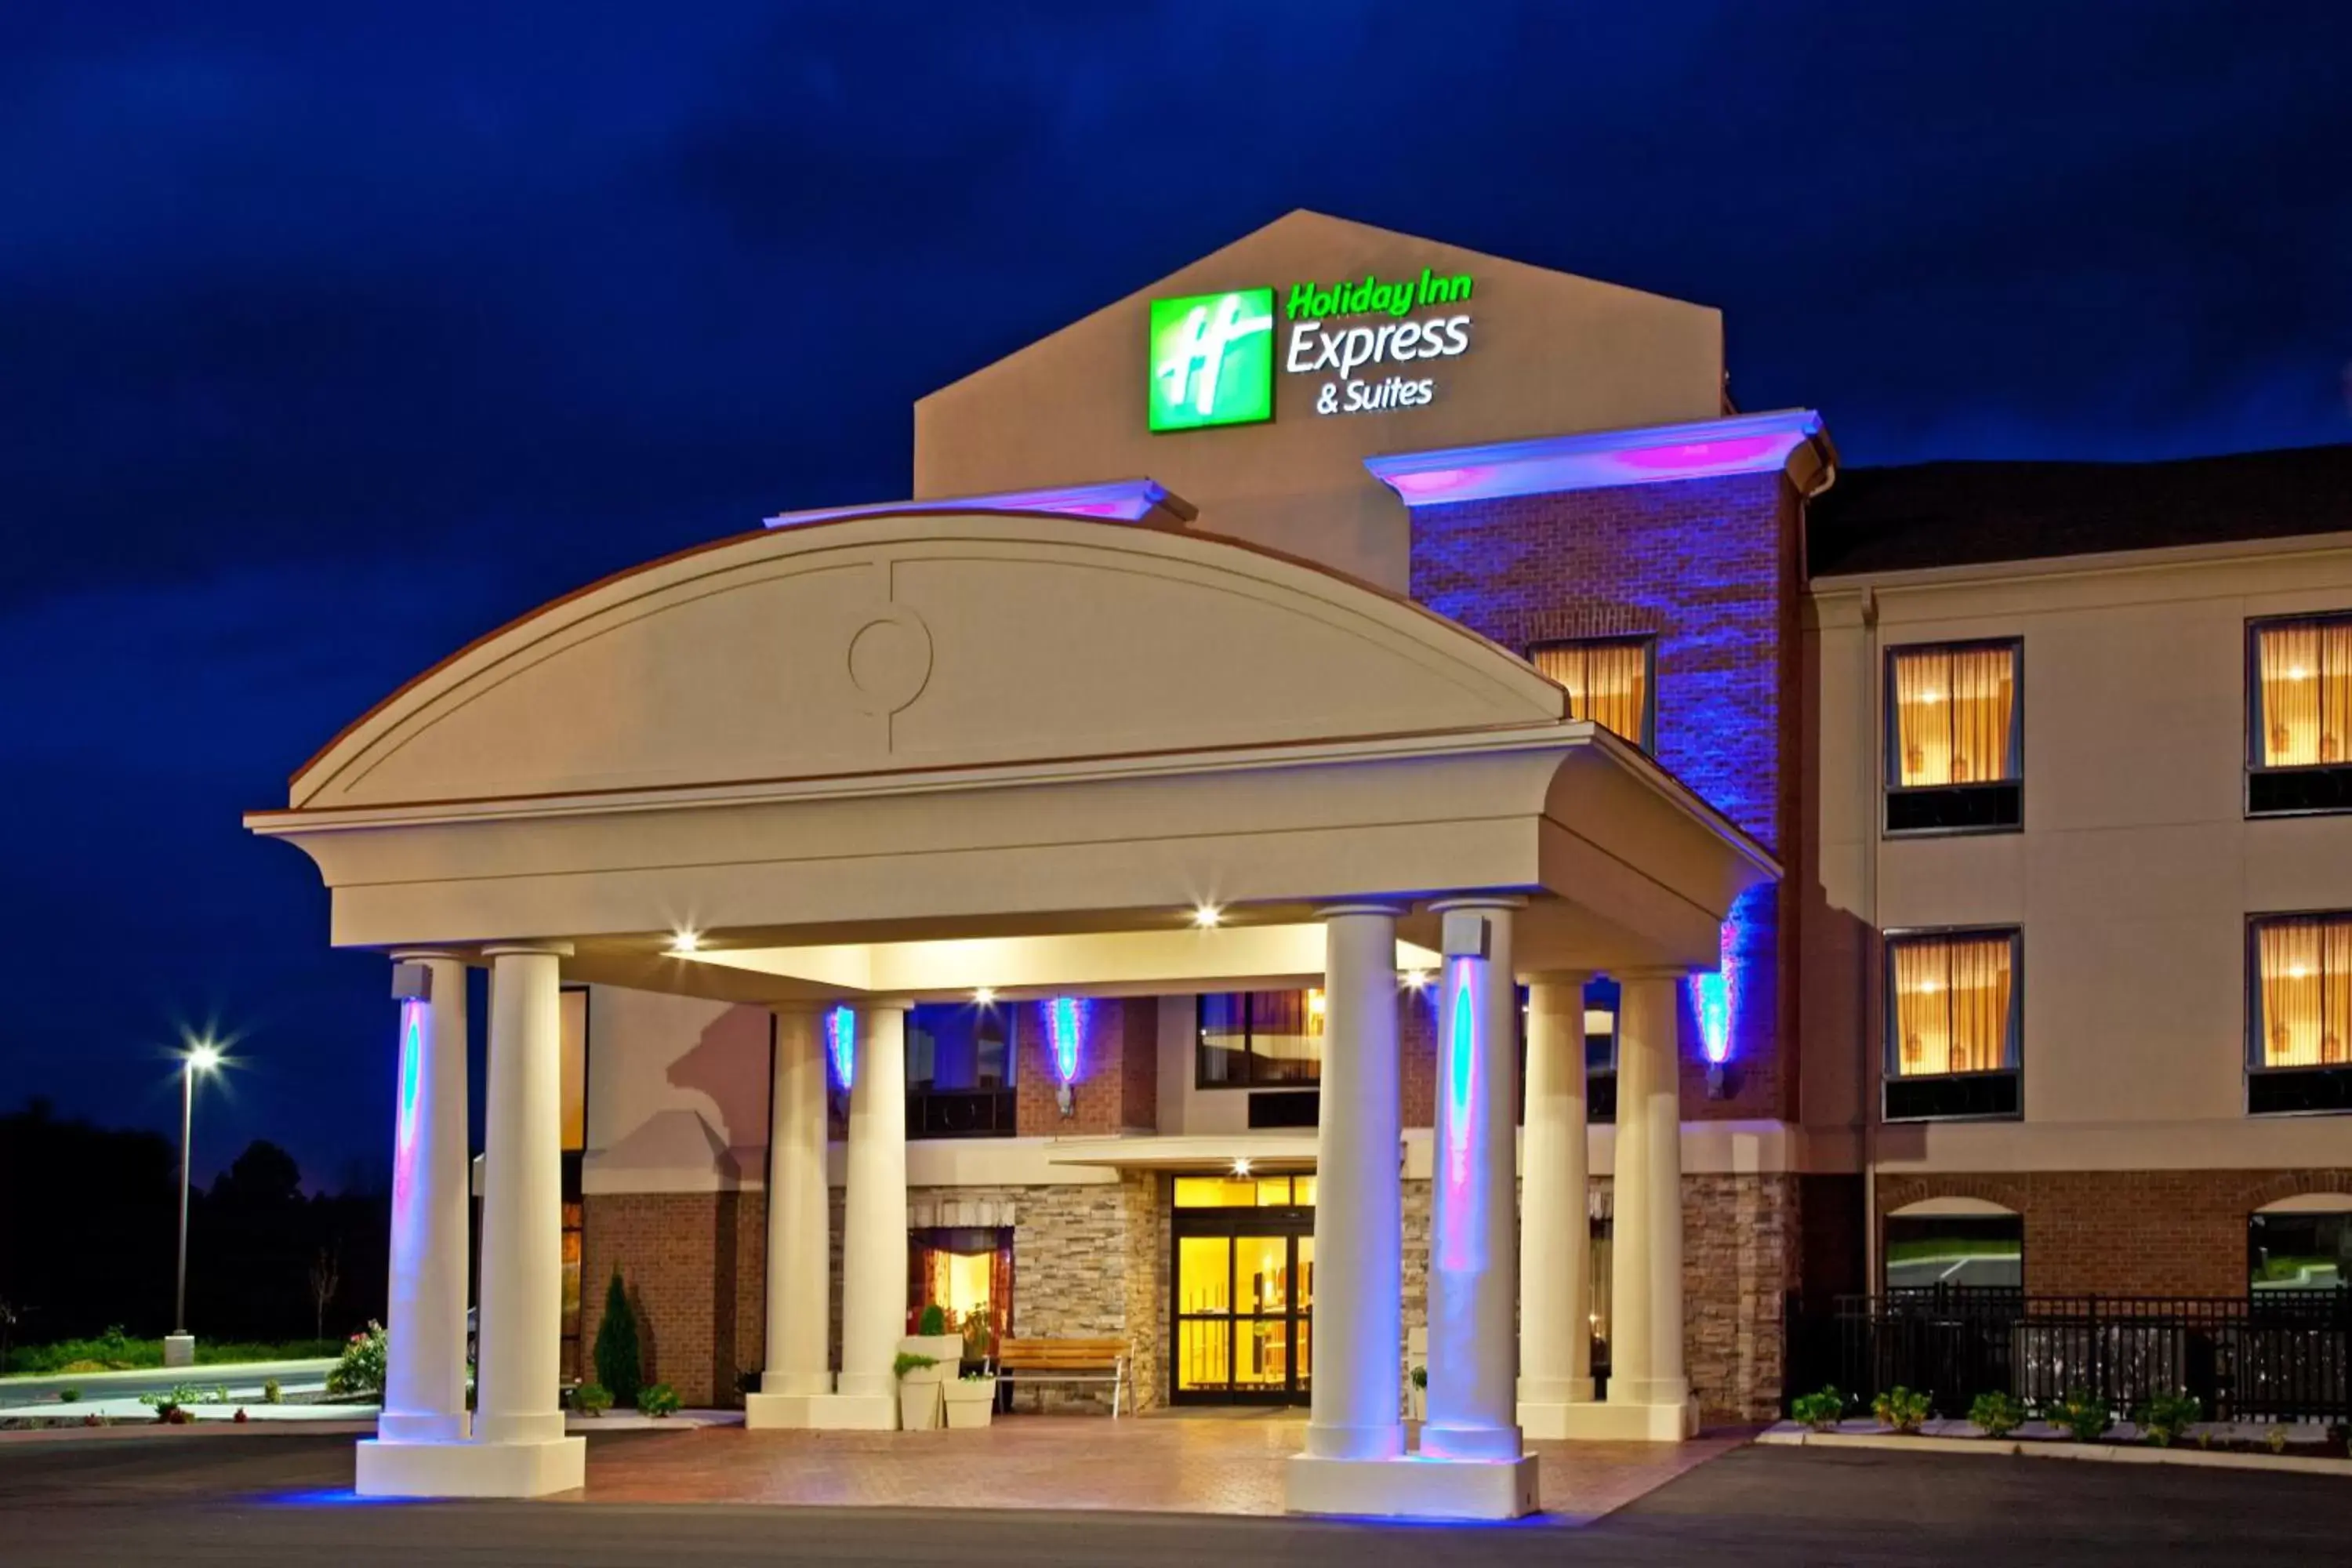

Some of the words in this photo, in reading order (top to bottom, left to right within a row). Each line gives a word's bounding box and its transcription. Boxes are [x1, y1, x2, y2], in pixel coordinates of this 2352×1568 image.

[1287, 276, 1414, 319] Holiday
[1418, 267, 1472, 305] Inn
[1156, 294, 1272, 415] H
[1287, 315, 1471, 379] Express
[1316, 383, 1338, 415] &
[1344, 376, 1433, 412] Suites
